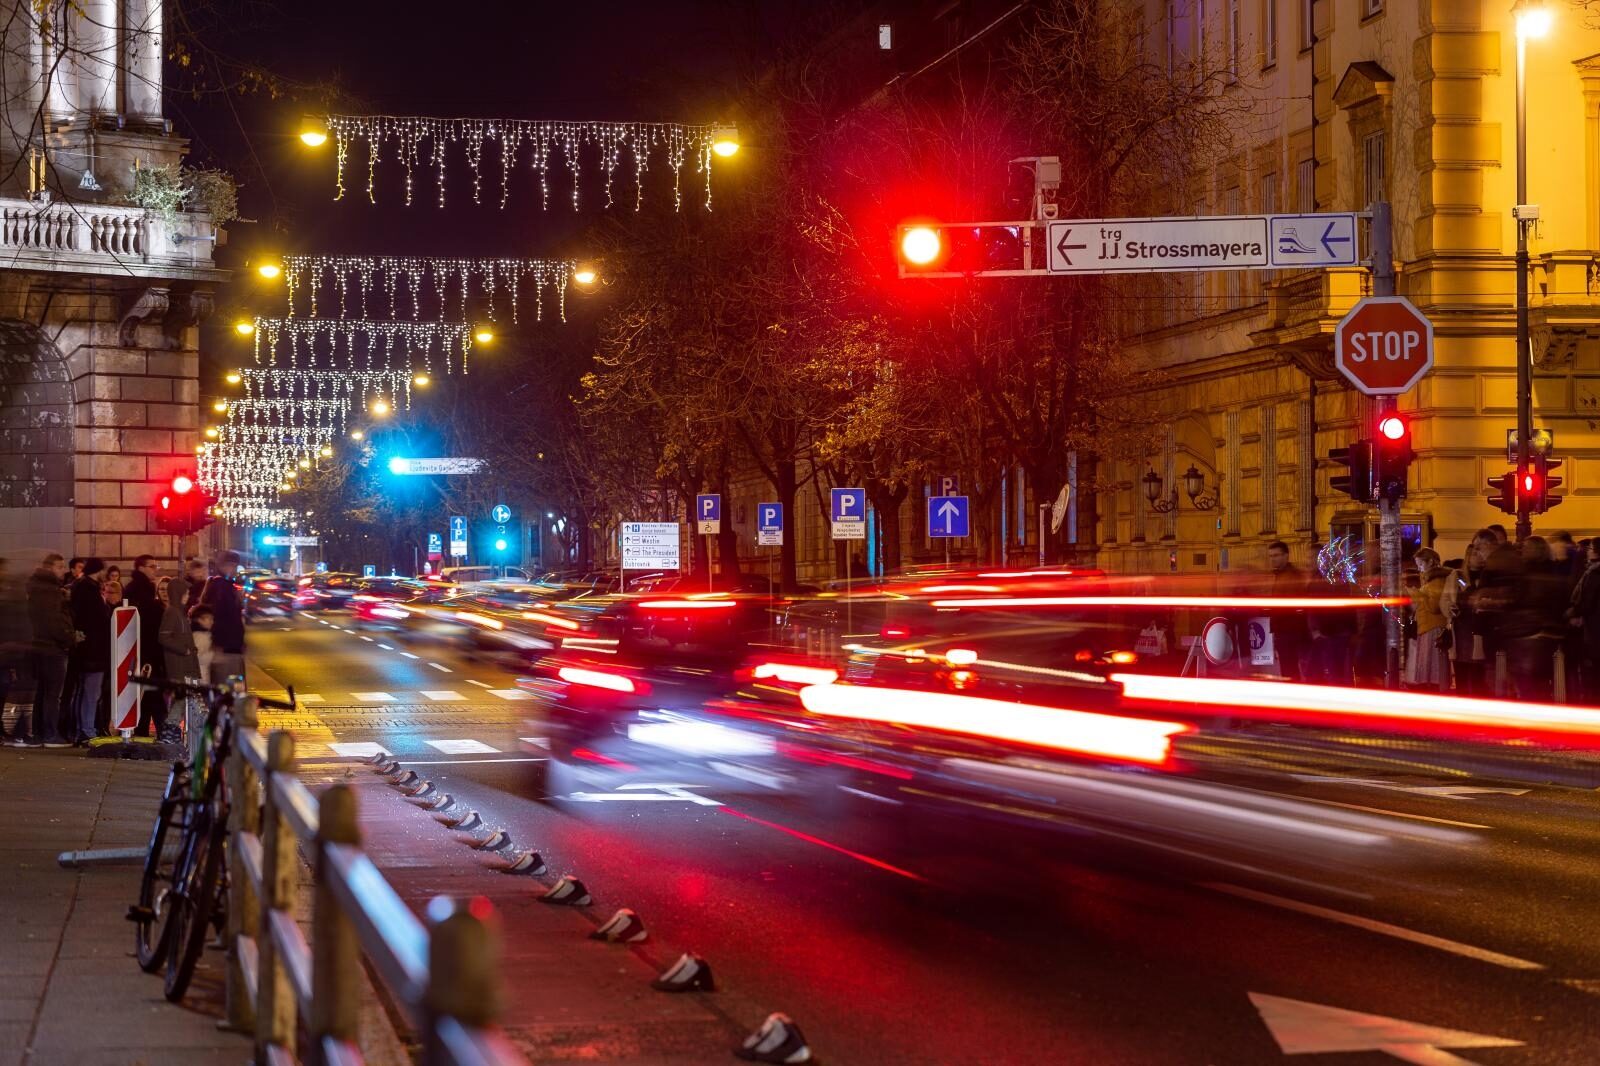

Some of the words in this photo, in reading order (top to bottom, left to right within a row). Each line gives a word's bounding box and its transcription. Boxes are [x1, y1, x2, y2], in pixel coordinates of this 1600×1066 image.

[1100, 228, 1122, 241] trg
[1125, 241, 1262, 260] Strossmayera
[1350, 330, 1420, 362] STOP
[942, 477, 953, 497] P
[703, 499, 714, 516] P
[841, 494, 856, 516] P
[765, 508, 776, 525] P
[429, 533, 437, 544] P
[455, 530, 462, 541] P
